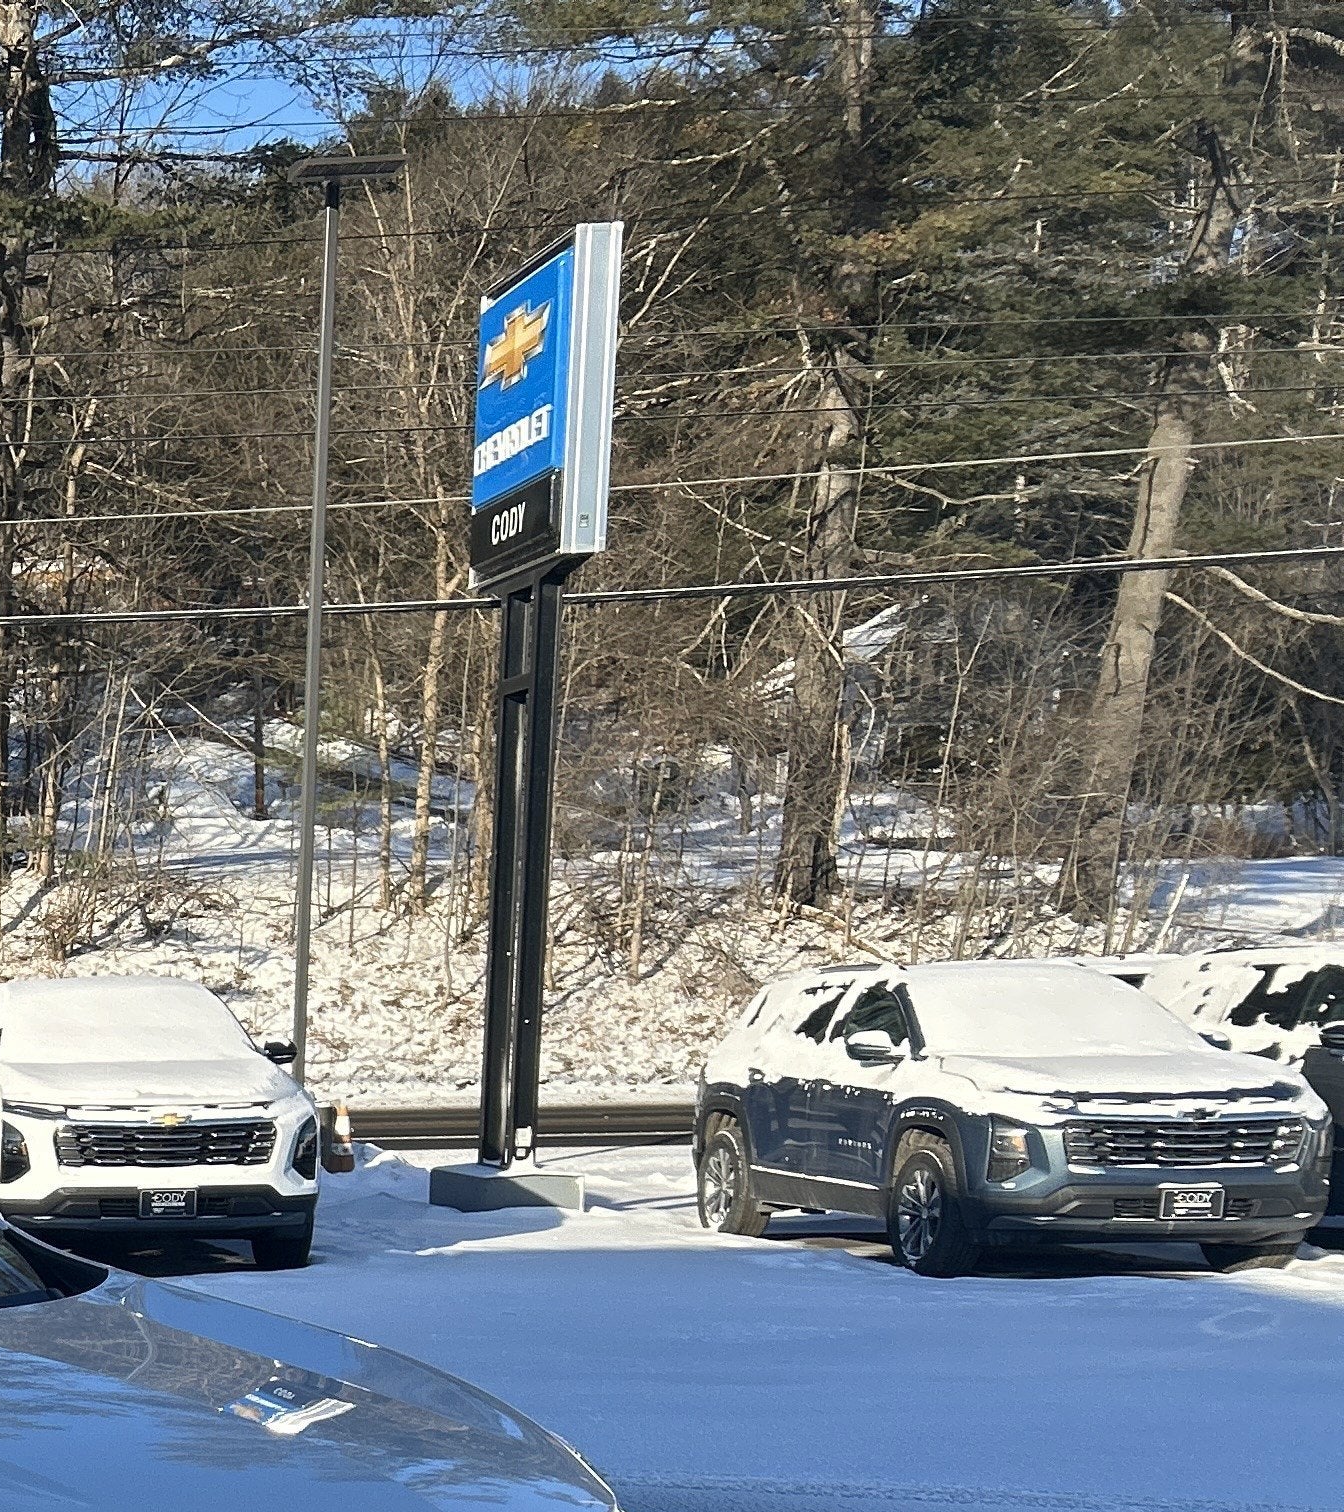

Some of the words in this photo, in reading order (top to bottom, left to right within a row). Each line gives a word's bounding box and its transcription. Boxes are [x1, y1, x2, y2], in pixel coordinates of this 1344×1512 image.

[491, 501, 526, 546] CODY
[153, 1191, 186, 1203] CODY
[1176, 1192, 1213, 1203] CODY
